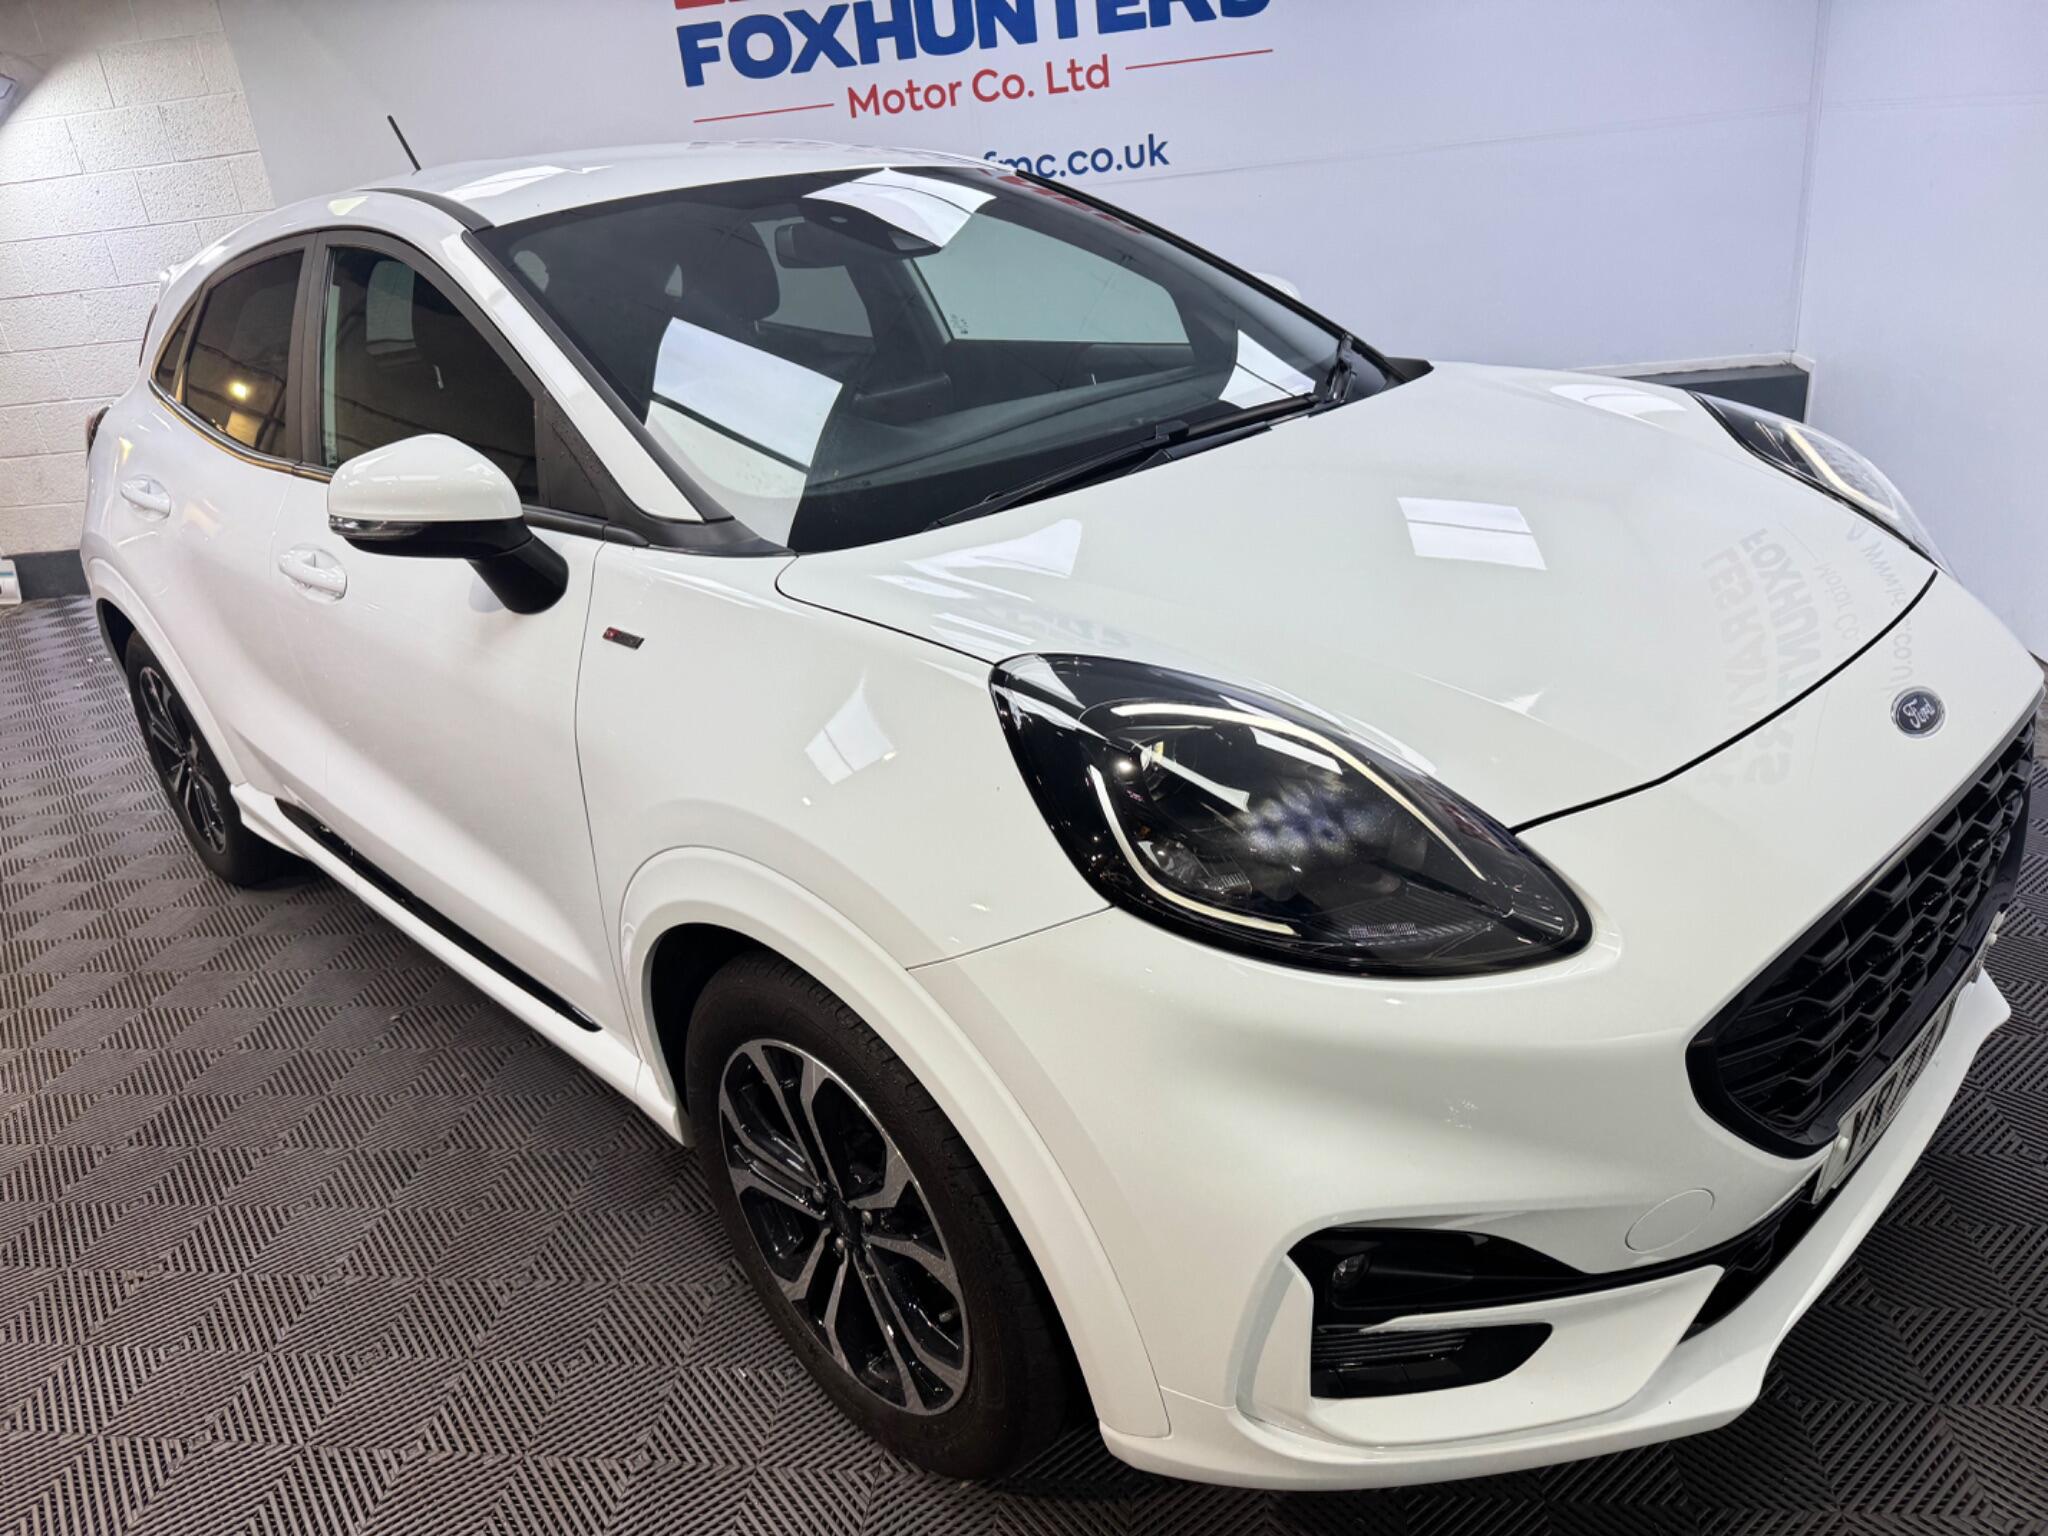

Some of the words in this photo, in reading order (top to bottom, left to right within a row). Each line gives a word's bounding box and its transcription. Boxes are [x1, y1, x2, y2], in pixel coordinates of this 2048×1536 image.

[676, 0, 1272, 88] FOXHUNTE
[847, 78, 963, 119] Motor
[971, 68, 1035, 103] Co.
[1045, 53, 1110, 95] Ltd
[1901, 697, 1936, 729] Ford
